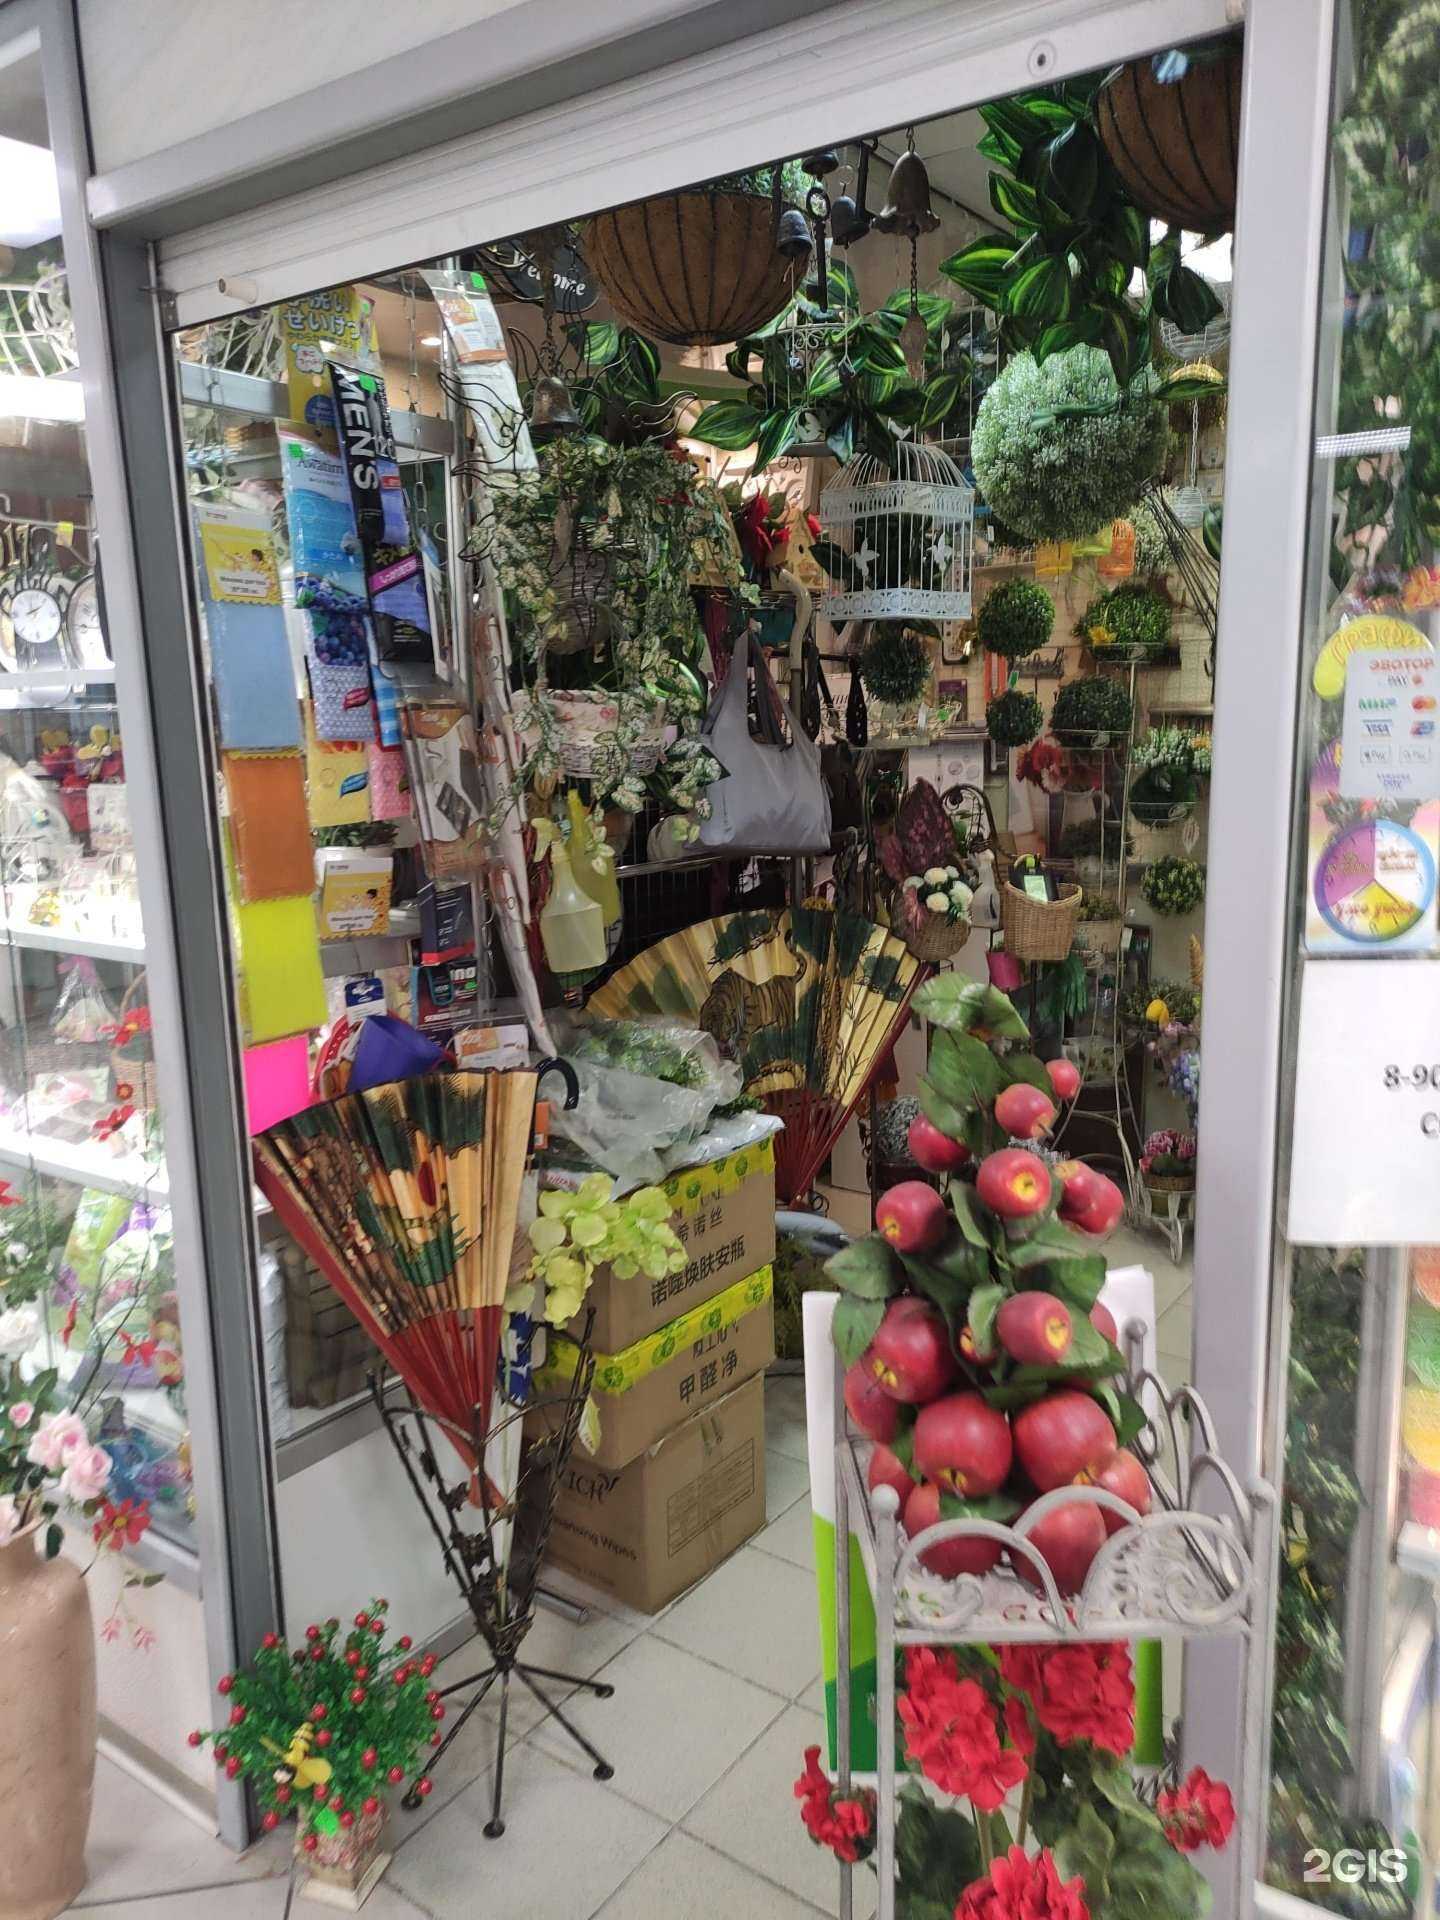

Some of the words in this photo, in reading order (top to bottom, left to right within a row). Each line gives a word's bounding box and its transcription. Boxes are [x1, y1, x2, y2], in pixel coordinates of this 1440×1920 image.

[513, 249, 586, 296] Welome
[334, 366, 380, 490] MEN'S
[680, 1348, 738, 1404] 甲醛净
